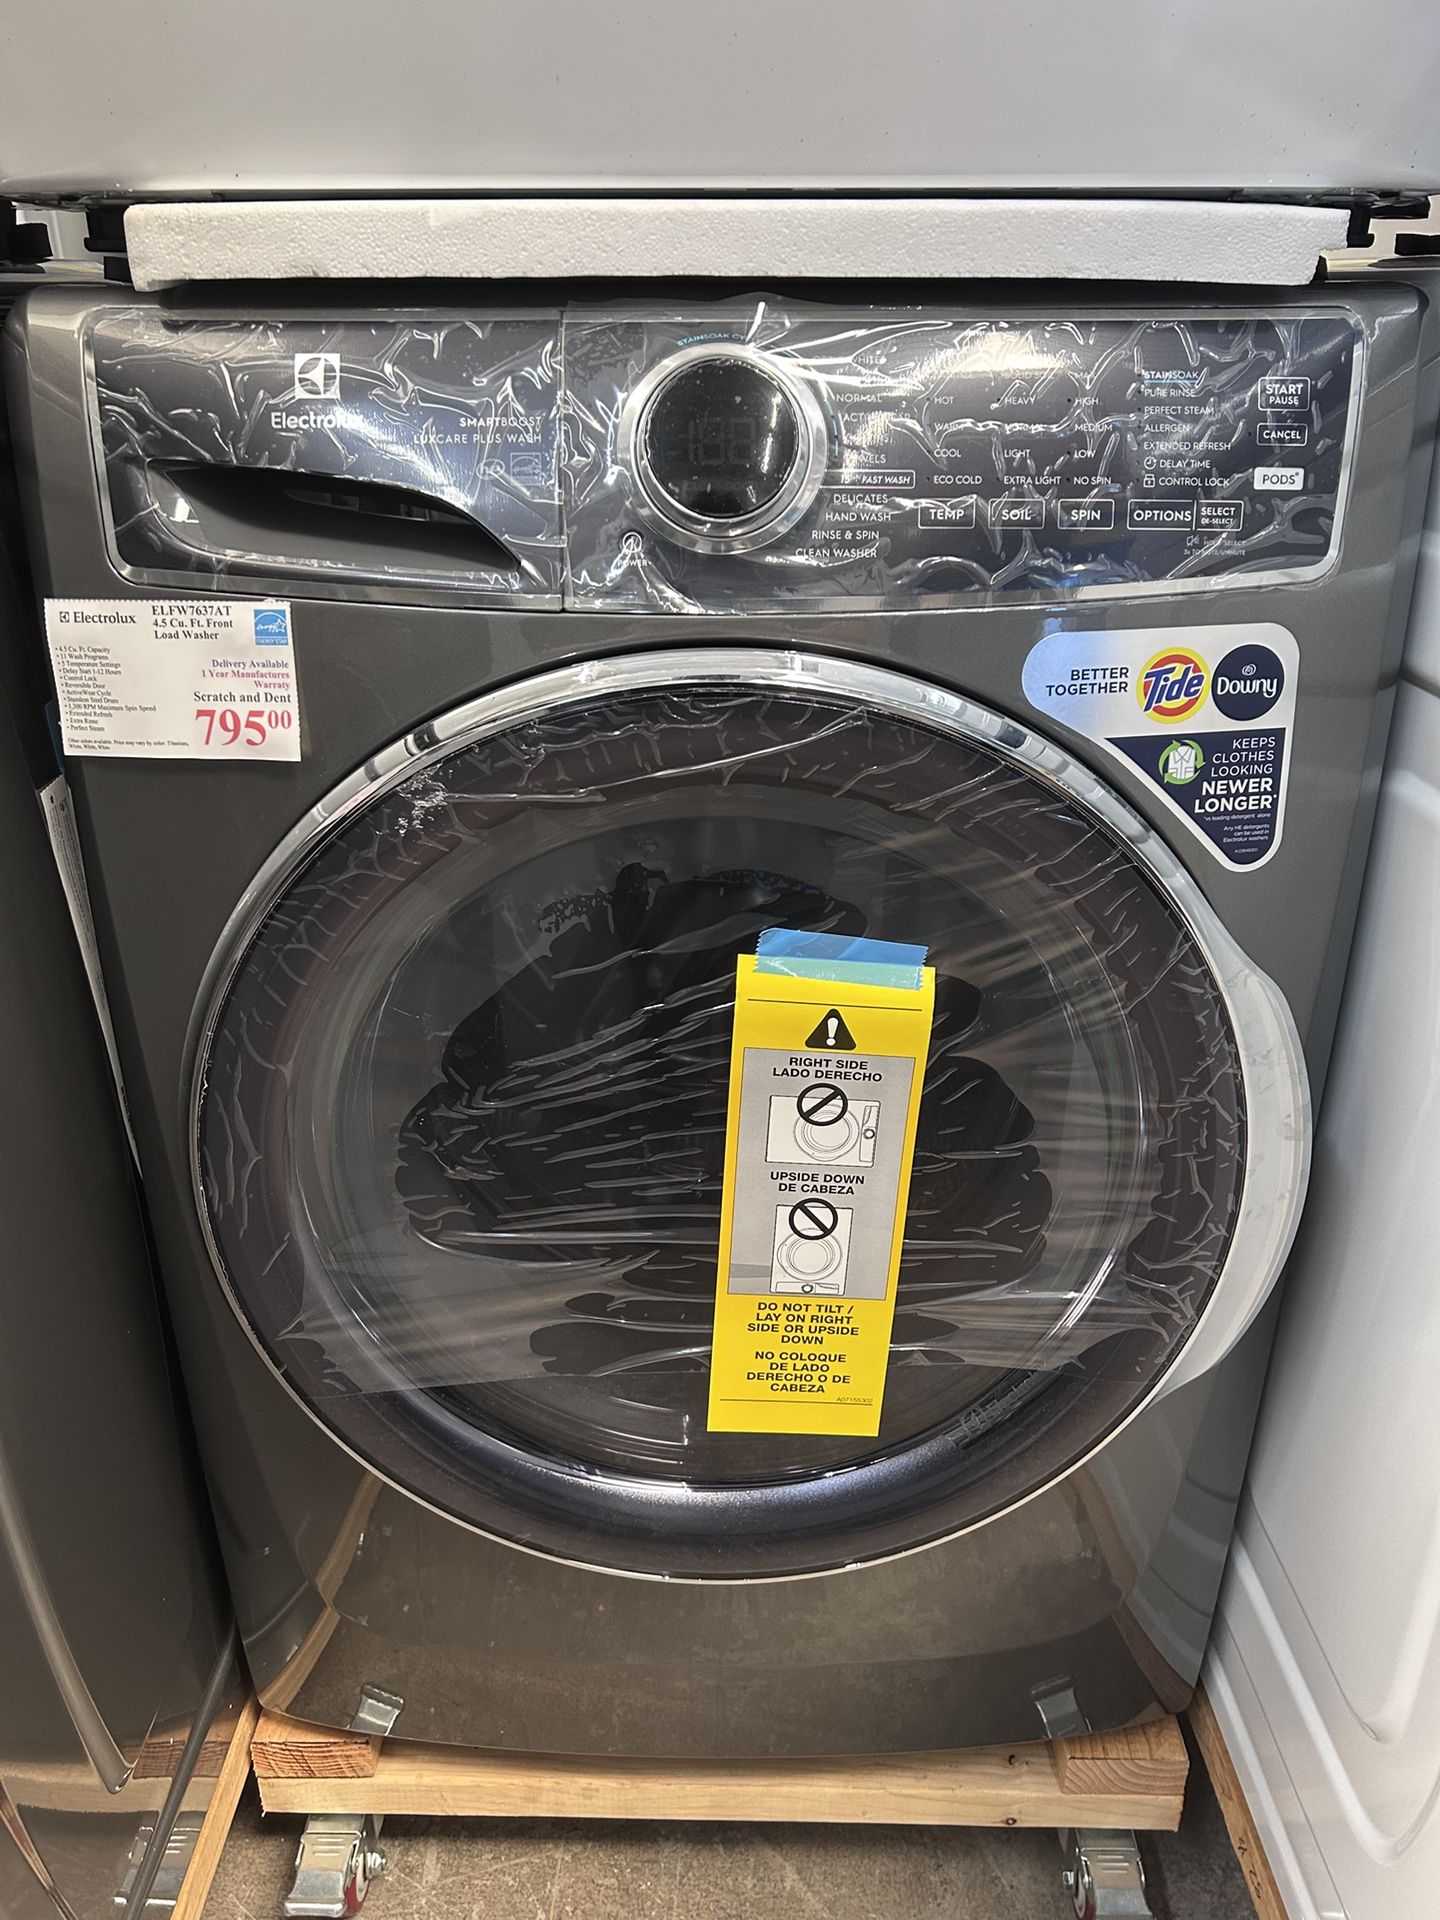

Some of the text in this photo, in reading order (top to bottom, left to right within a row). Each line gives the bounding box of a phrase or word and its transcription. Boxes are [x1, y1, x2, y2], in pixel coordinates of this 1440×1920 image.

[676, 333, 729, 346] STAINSOAK
[1144, 371, 1199, 379] STAINSOAK
[1144, 389, 1196, 397] PURE RINSE
[1266, 384, 1303, 395] START
[836, 394, 882, 403] NORMAL
[1269, 396, 1299, 405] PAUSE
[1144, 406, 1215, 415] PERFECT STEAM
[271, 411, 363, 429] Electrol
[459, 417, 542, 427] SMARTBOOST
[1144, 424, 1189, 432] ALLERGEN
[414, 433, 542, 444] LUXCARE PLUS WASH
[1263, 430, 1301, 439] CANCEL
[1144, 442, 1231, 450] EXTENDED REFRESH
[1074, 450, 1096, 458] LOW
[1159, 460, 1211, 468] DELAY TIME
[861, 475, 883, 484] FAST
[885, 476, 910, 484] WASH
[934, 476, 982, 484] ECO COLD
[1004, 476, 1061, 484] EXTRA LIGHT
[1074, 476, 1089, 484] NO
[1159, 477, 1230, 486] CONTROL LOCK
[833, 494, 888, 504] DELICATES
[929, 510, 964, 520] TEMP
[1002, 509, 1032, 520] SOIL
[1071, 510, 1101, 520] SPIN
[1133, 510, 1192, 521] OPTIONS
[1201, 507, 1235, 516] SELECT
[825, 512, 891, 522] HAND WASH
[812, 530, 879, 540] RINSE & SPIN
[795, 548, 877, 558] CLEAN WASHER
[152, 605, 232, 616] ELFW7637AT
[74, 612, 136, 624] Electrolux
[153, 619, 233, 628] 4.5 Cu. Ft. Front
[154, 631, 220, 640] Load Washer
[212, 659, 289, 669] Delivery Available
[209, 670, 229, 678] Year
[231, 670, 290, 679] Manufactures
[1070, 666, 1129, 681] BETTER
[254, 681, 290, 690] Warraty
[1046, 681, 1128, 697] TOGETHER
[1143, 663, 1205, 713] Tide
[1216, 676, 1278, 697] Downy
[96, 690, 111, 698] Cycle
[193, 691, 291, 703] Scratch and Dent
[1232, 736, 1276, 749] KEEPS
[1212, 750, 1274, 764] CLOTHES
[1211, 764, 1272, 777] LOOKING
[1202, 778, 1272, 796] NEWER
[789, 1057, 869, 1069] RIGHT SIDE
[773, 1068, 882, 1082] LADO DERECHO
[770, 1171, 865, 1184] UPSIDE DOWN
[778, 1183, 855, 1194] DE CABEZA
[758, 1303, 854, 1314] DO NOT TILT /
[756, 1313, 853, 1324] LAY ON RIGHT
[747, 1323, 859, 1335] SIDE OR UPSIDE
[781, 1335, 824, 1345] DOWN
[755, 1352, 846, 1362] NO COLOQUE
[769, 1363, 830, 1372] DE LADO
[747, 1372, 851, 1383] DERECHO O DE
[770, 1383, 825, 1393] CABEZA
